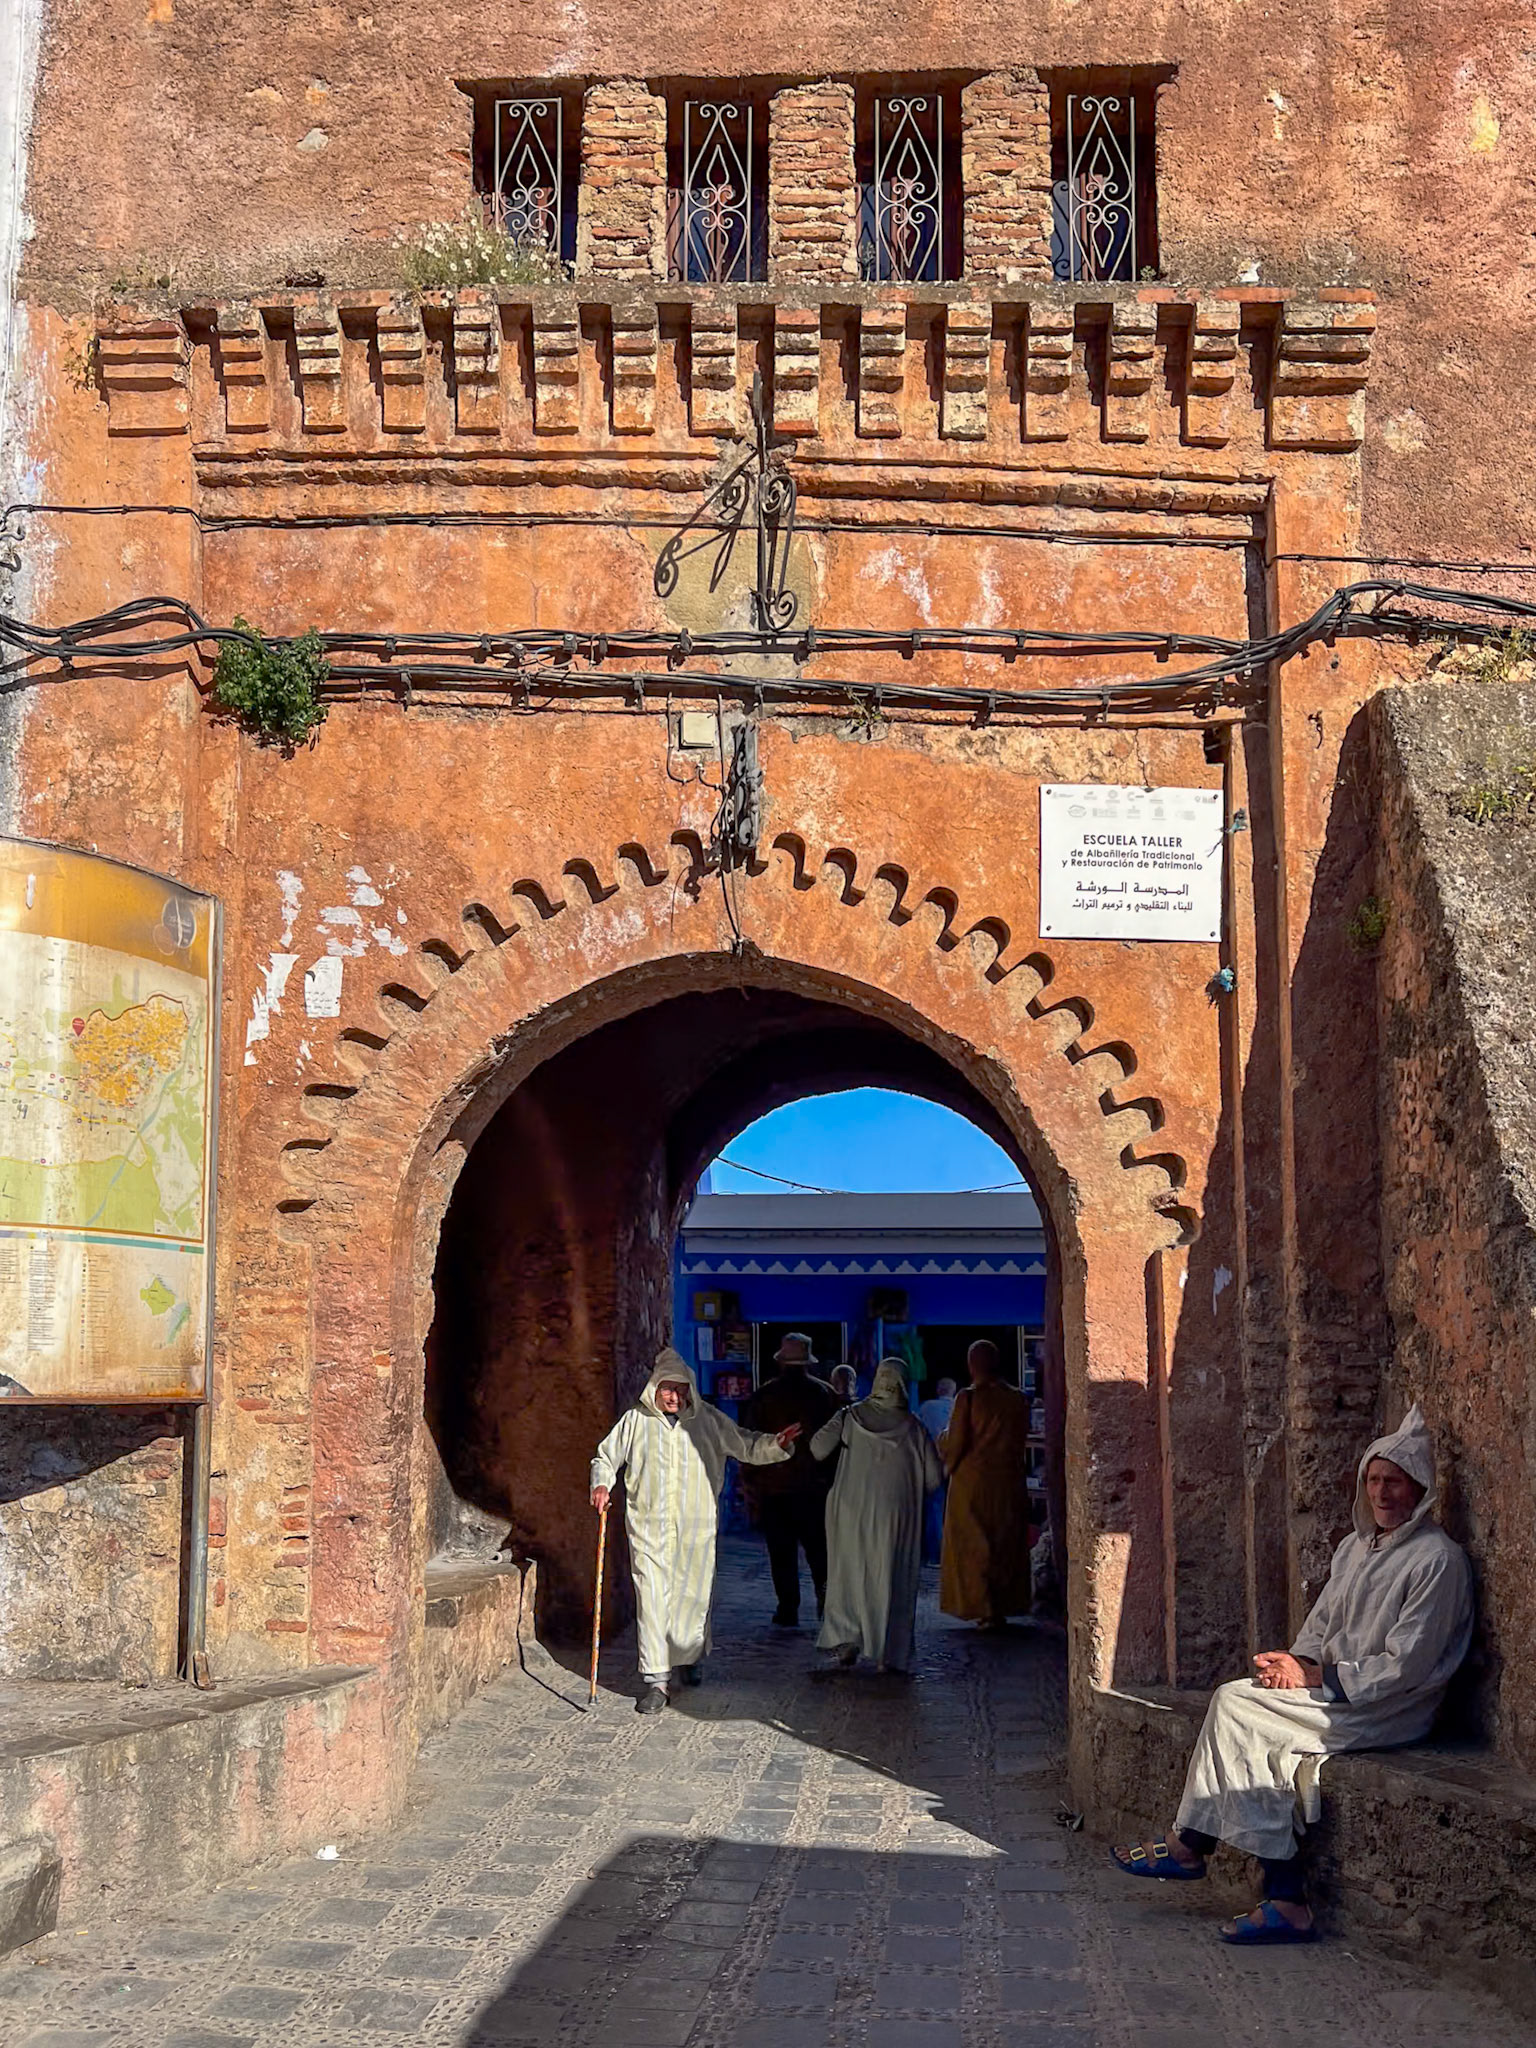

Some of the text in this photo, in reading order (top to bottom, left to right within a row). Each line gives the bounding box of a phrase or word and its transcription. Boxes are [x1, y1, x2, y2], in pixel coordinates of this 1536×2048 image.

[1083, 834, 1183, 848] ESCUELA TALLER
[1070, 848, 1195, 861] de Albañilería Tradicional
[1061, 858, 1203, 871] y Restauración de Patrimonio
[1126, 903, 1132, 911] و
